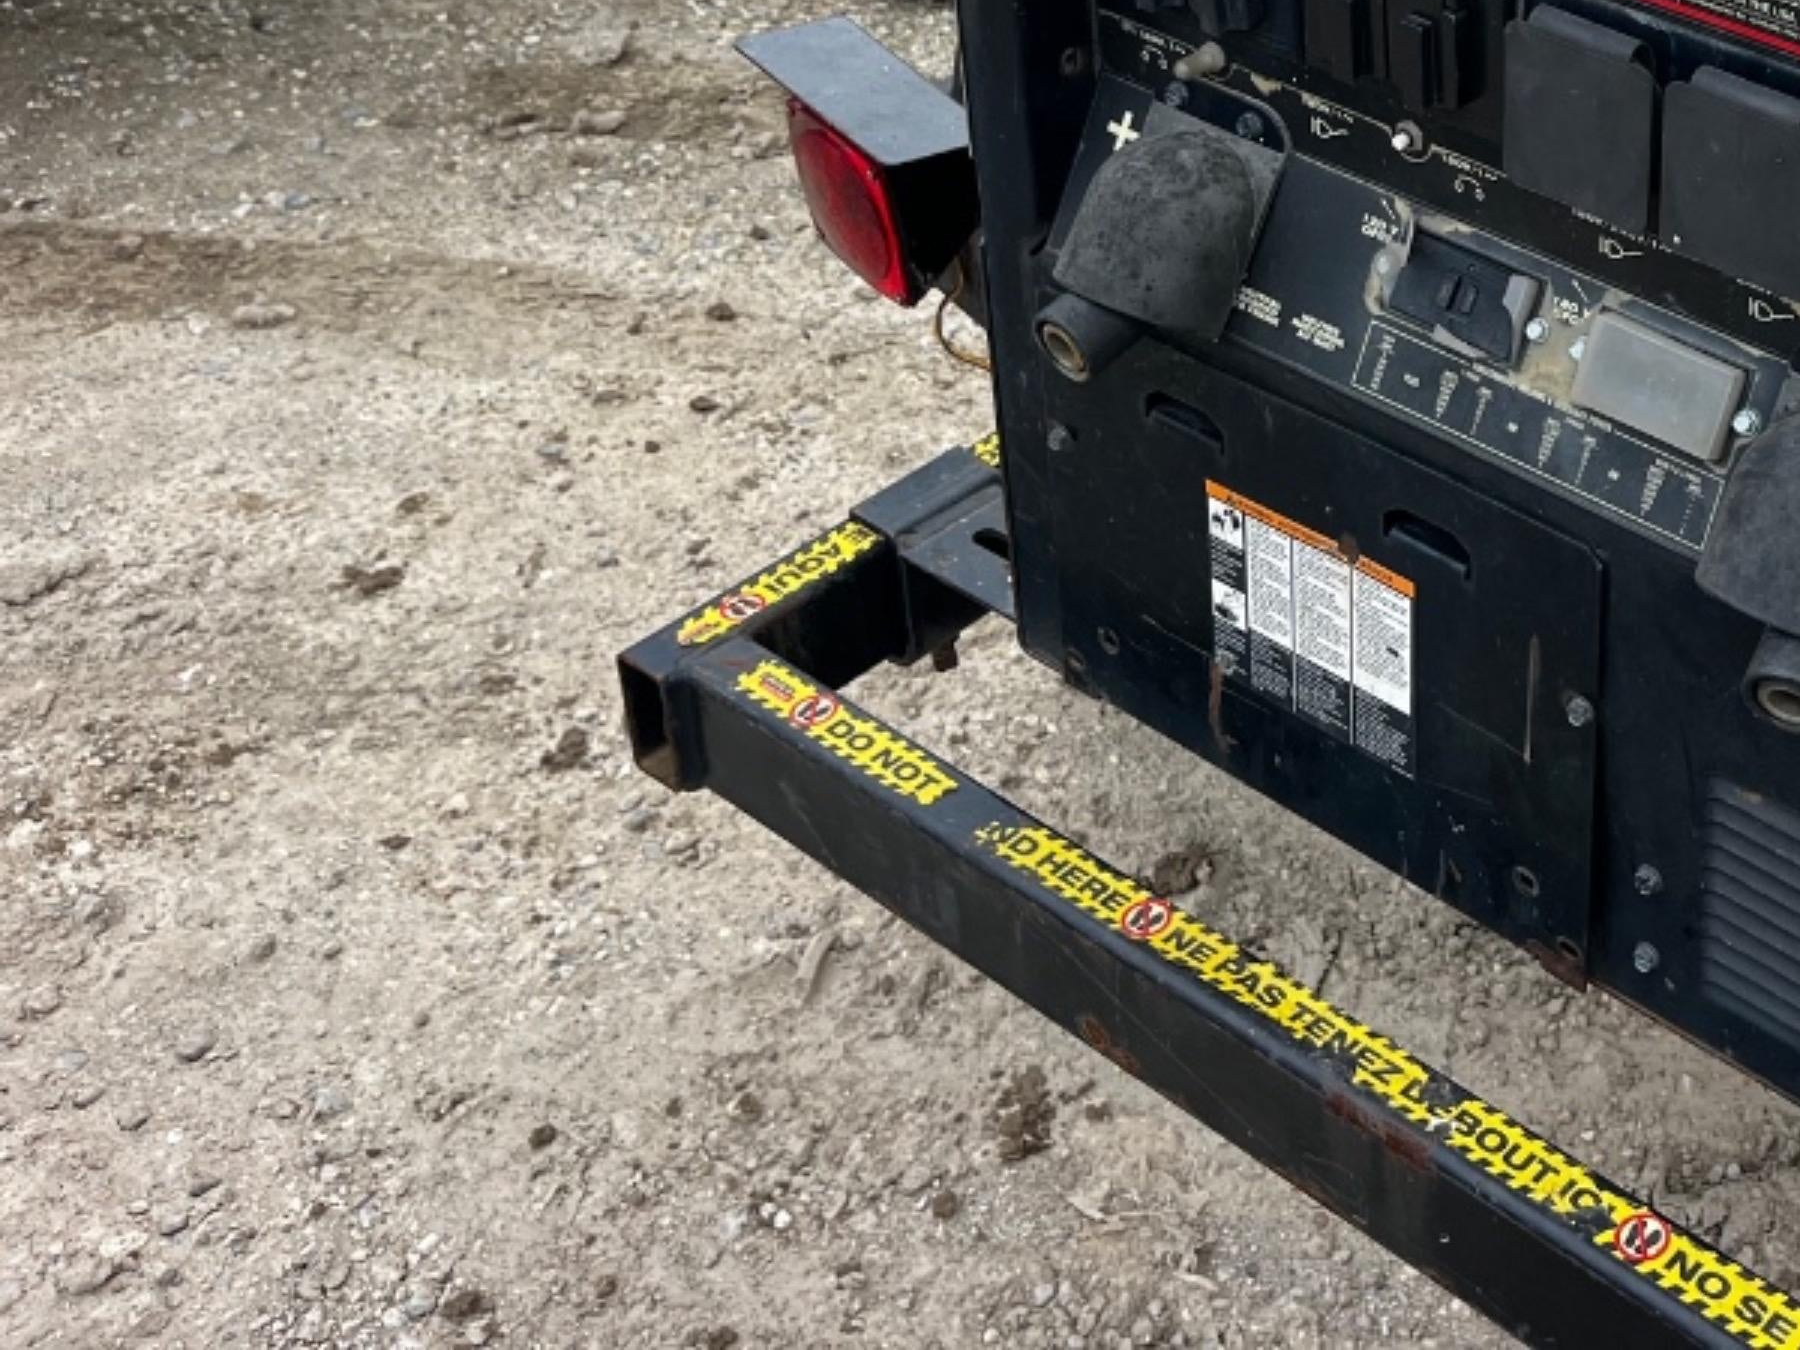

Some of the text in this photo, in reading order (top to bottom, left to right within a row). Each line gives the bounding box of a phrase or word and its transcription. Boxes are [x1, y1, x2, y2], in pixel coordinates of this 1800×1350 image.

[825, 706, 947, 792] DO NOT
[1035, 852, 1132, 912] HERE
[1161, 928, 1215, 964] NE
[1216, 957, 1288, 1010] PAS
[1289, 1001, 1405, 1088] TENEZ
[1665, 1249, 1798, 1345] NO SE
